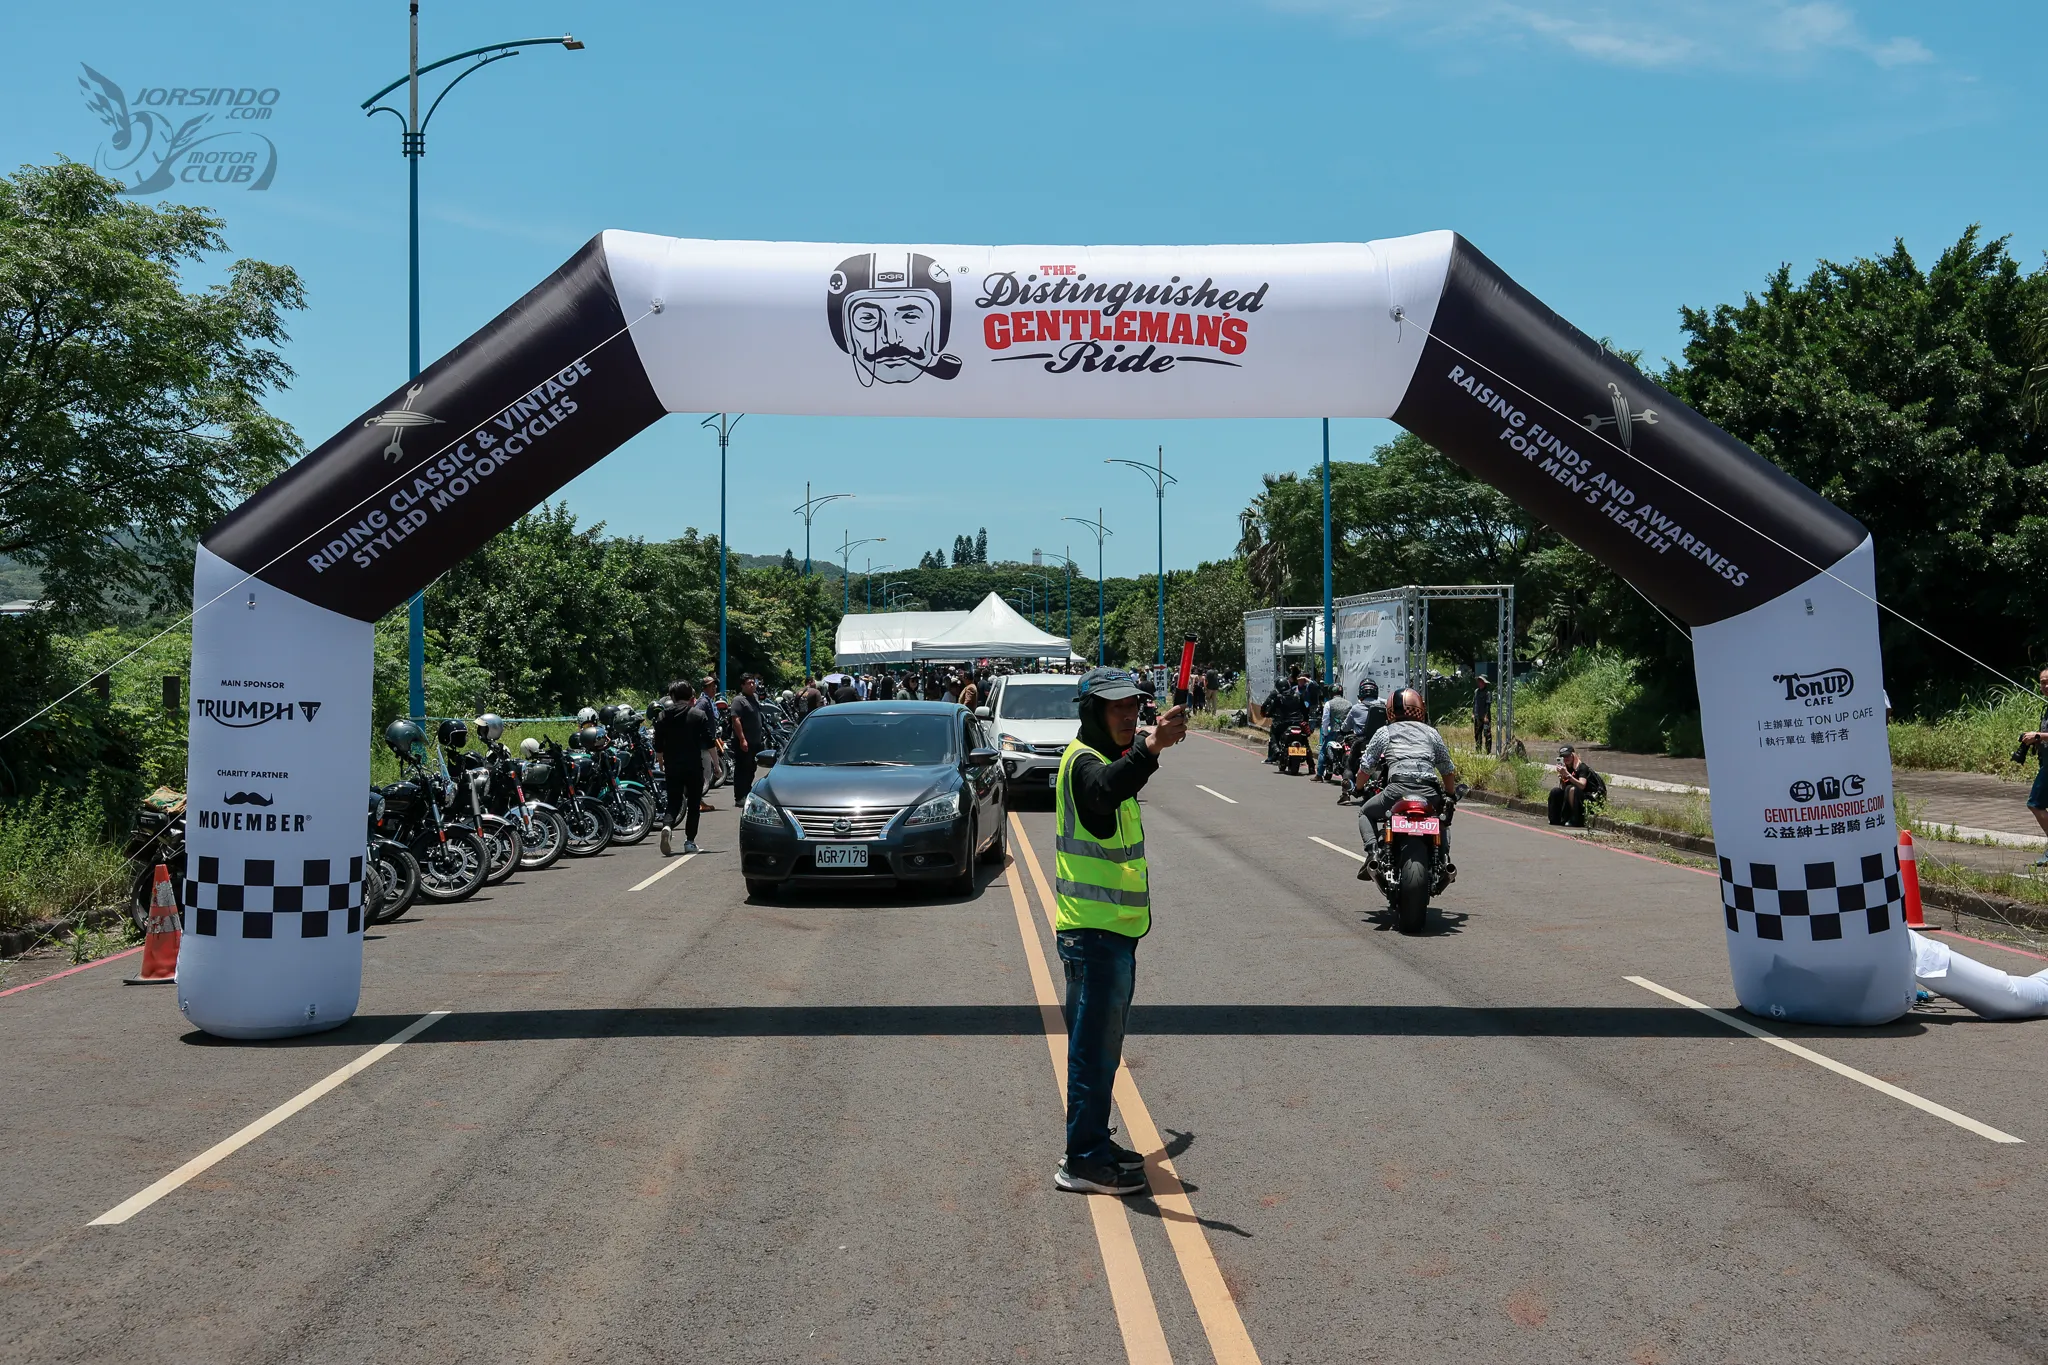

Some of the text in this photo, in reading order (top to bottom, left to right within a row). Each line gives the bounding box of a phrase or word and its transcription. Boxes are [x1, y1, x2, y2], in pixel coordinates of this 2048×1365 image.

[1039, 265, 1077, 276] THE
[975, 270, 1270, 317] Distinguished
[982, 309, 1249, 355] GENTLEMAN'S
[1044, 339, 1176, 373] Ride
[307, 358, 592, 573] RIDING CLASSIC & VINTAGE
[1448, 365, 1750, 587] RAISING FUNDS AND AWARENESS
[352, 395, 579, 569] STYLED MOTORCYCLES
[1499, 427, 1672, 555] FOR MEN'S HEALTH
[220, 679, 285, 689] MAIN SPONSOR
[197, 699, 294, 728] TRIUMPH
[1804, 696, 1834, 707] CAFE
[1763, 707, 1873, 730] 主辦單位 TON UP CAFE
[1765, 734, 1807, 747] 執行單位
[217, 769, 289, 779] CHARITY PARTNER
[199, 810, 305, 832] MOVEMBER
[1764, 794, 1885, 823] GENTLEMANSRIDE.COM
[1763, 813, 1886, 839] 公益紳士路騎 台北
[817, 850, 867, 864] AGR-7178
